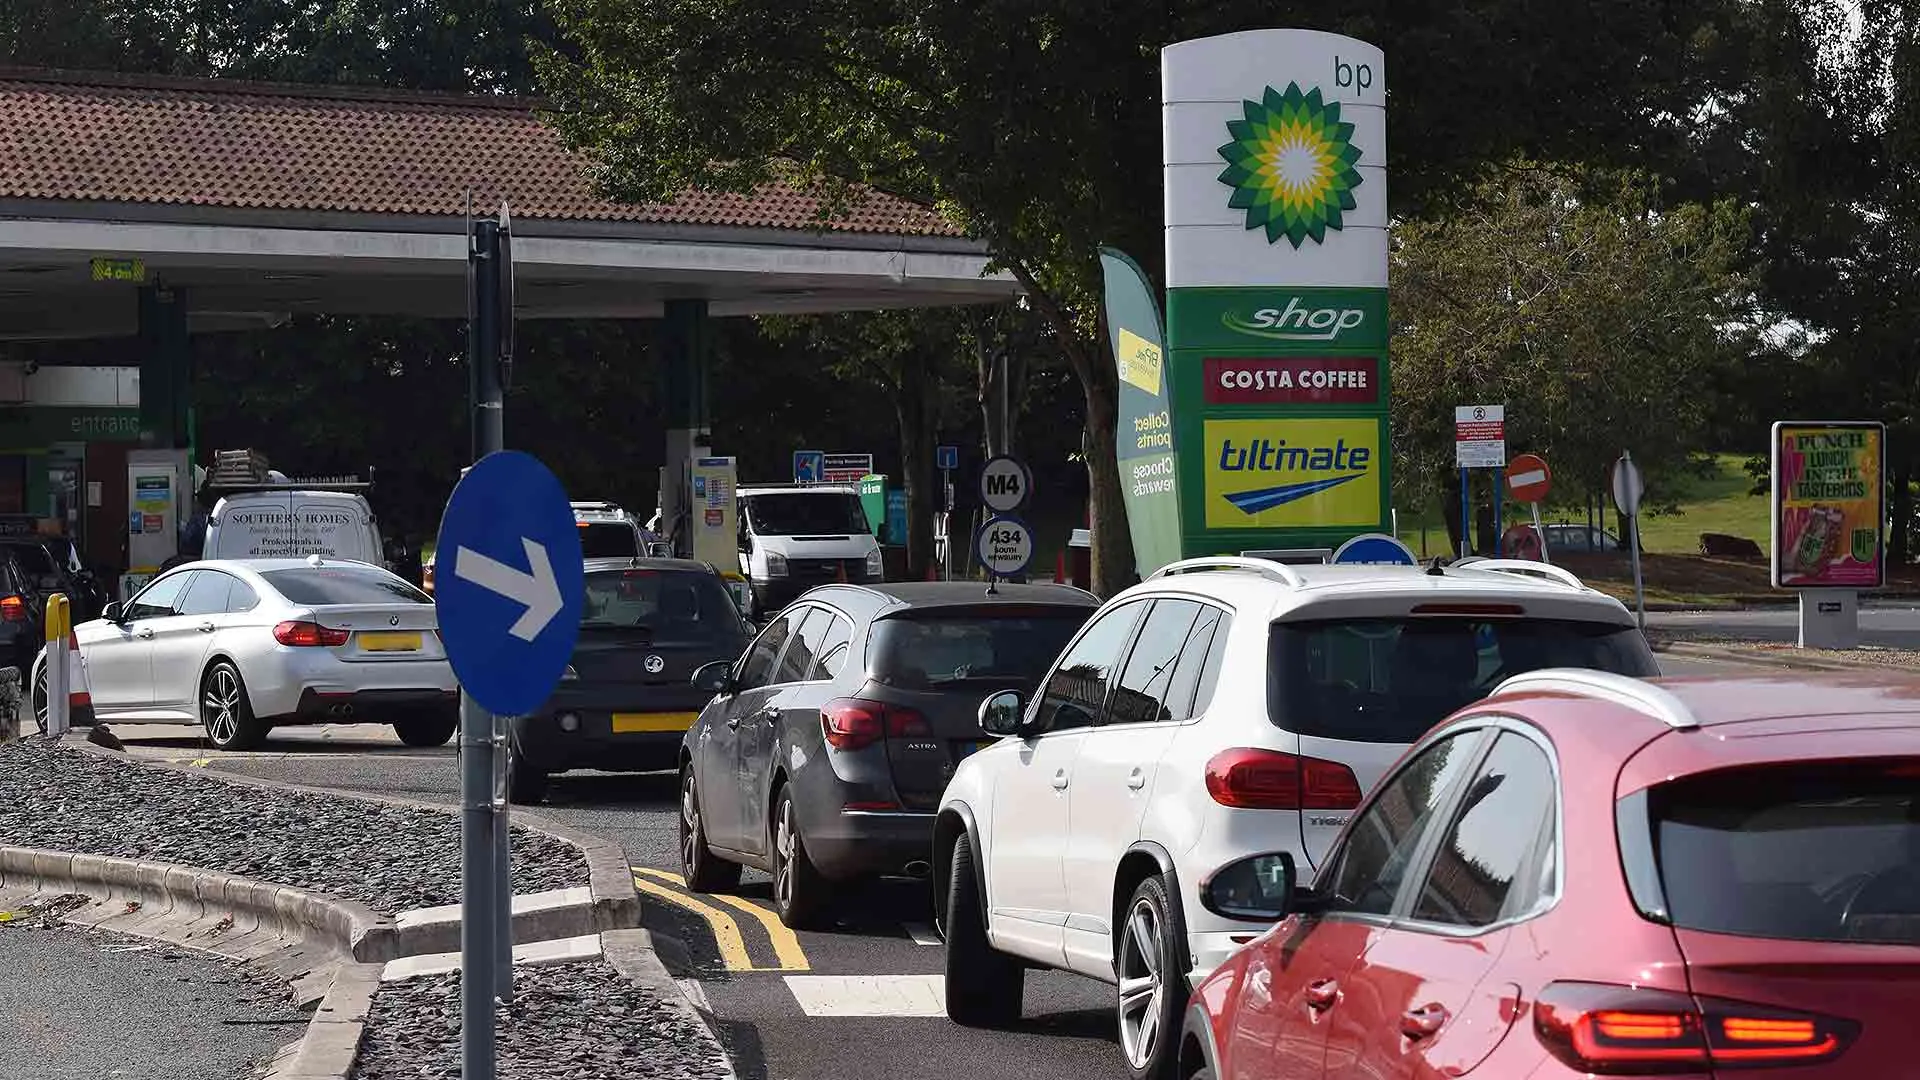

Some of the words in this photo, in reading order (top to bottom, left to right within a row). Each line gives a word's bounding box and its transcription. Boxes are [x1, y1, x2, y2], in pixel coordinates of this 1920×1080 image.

[1334, 55, 1373, 97] bp
[1253, 297, 1365, 340] shop
[1220, 370, 1292, 390] COSTA
[1298, 370, 1367, 388] COFFEE
[71, 415, 140, 433] entranc
[1797, 433, 1863, 450] PUNCH
[1809, 451, 1849, 467] LUNCH
[986, 474, 1020, 495] M4
[1797, 481, 1865, 498] TASTEBUDS
[232, 513, 300, 524] SOUTHERN
[305, 513, 350, 524] HOMES
[989, 530, 1022, 544] A34
[994, 546, 1017, 554] SOUTH
[1309, 815, 1349, 826] TIGU
